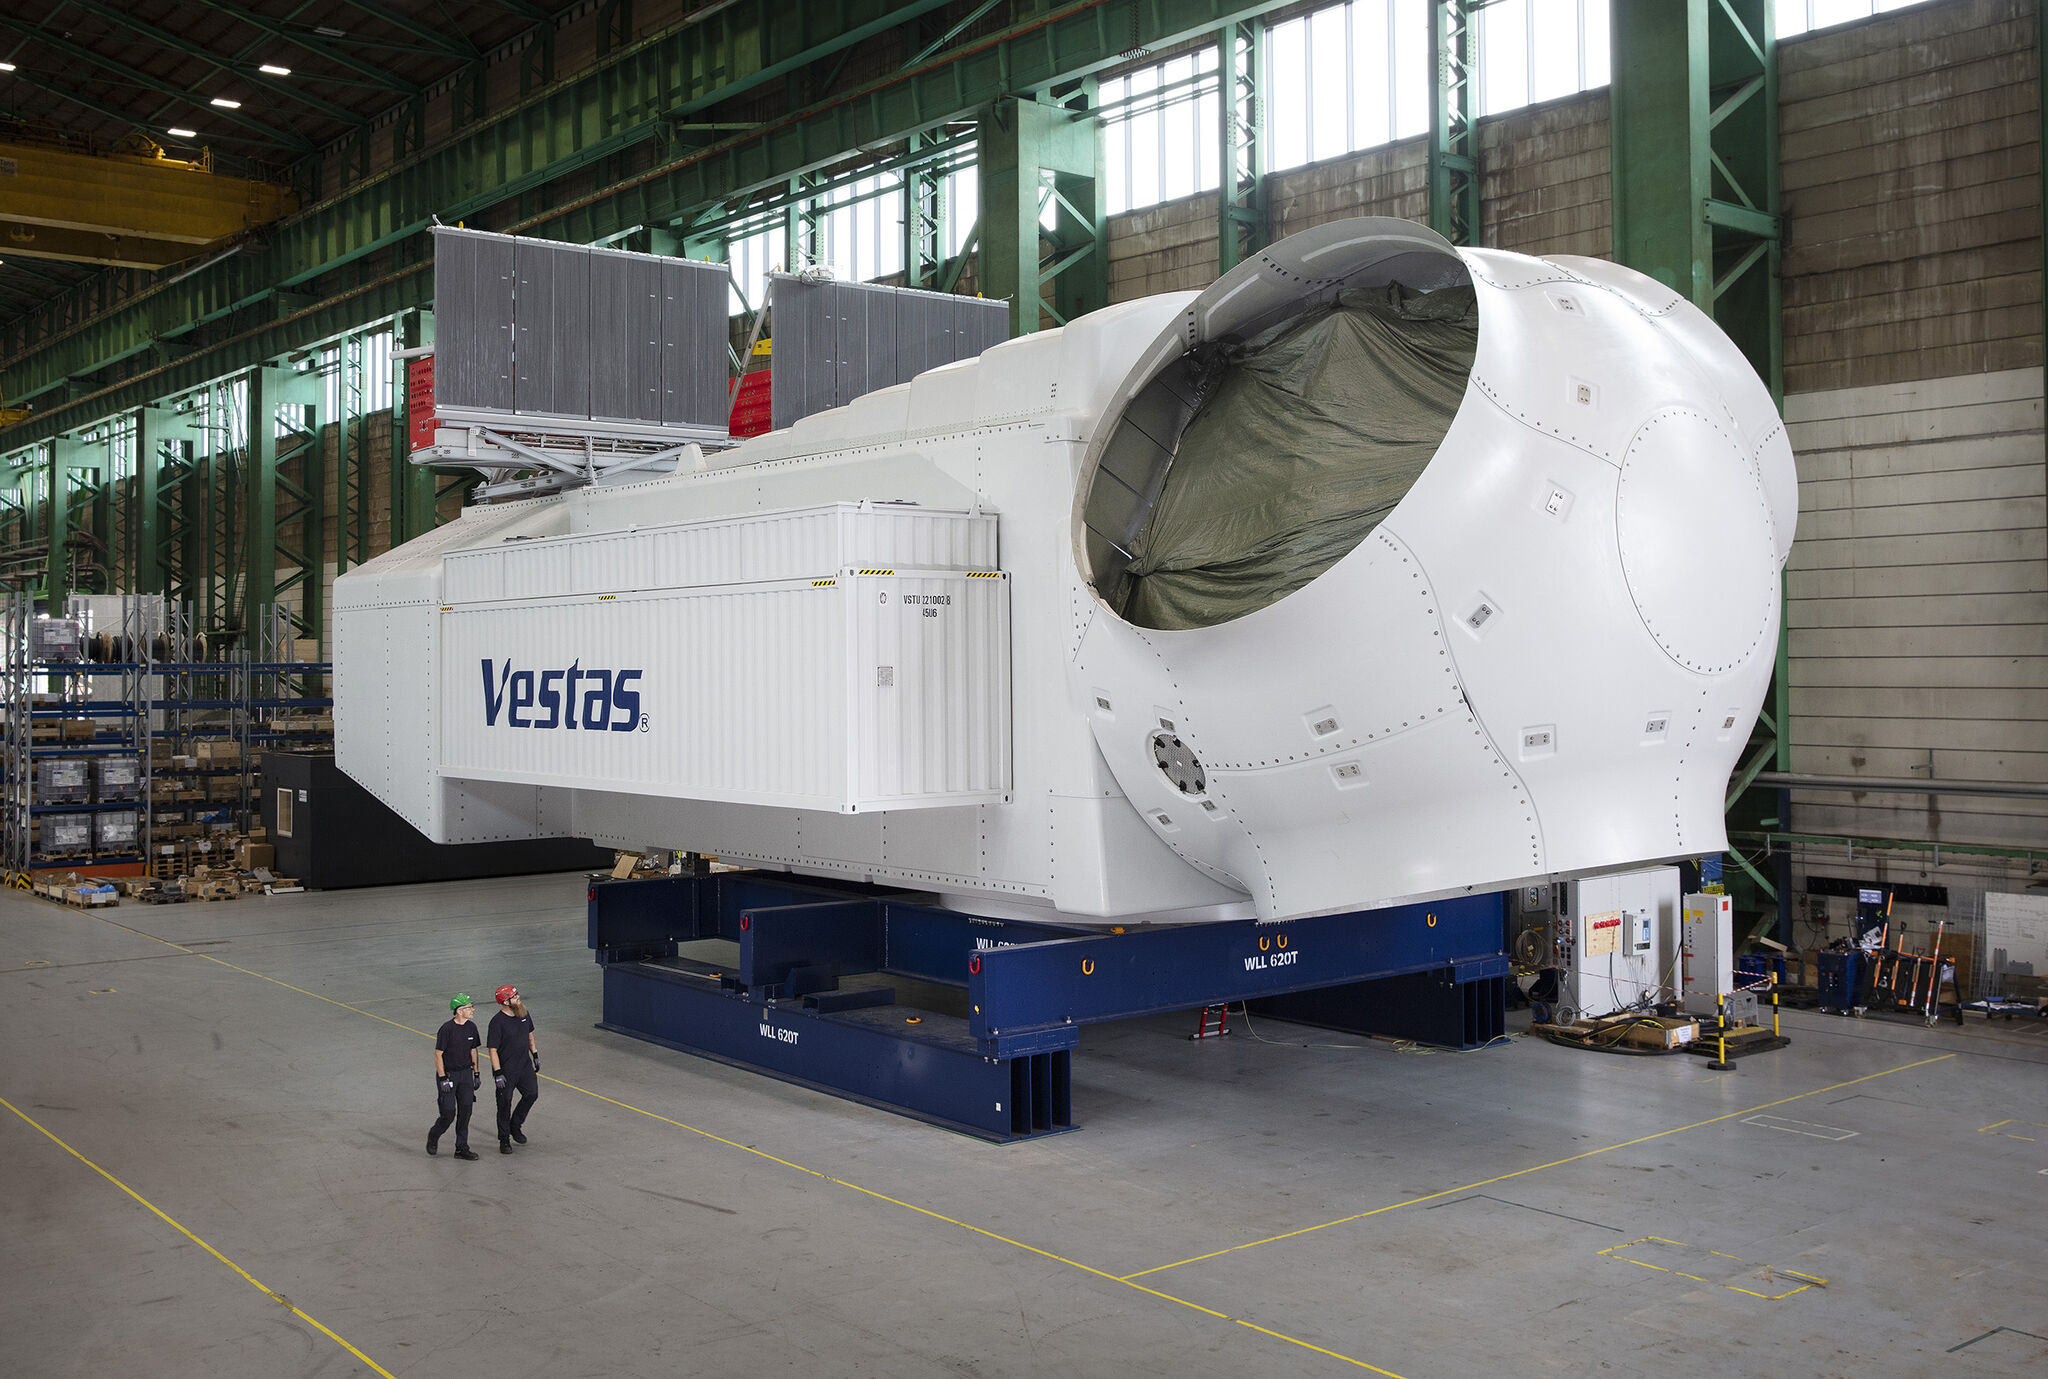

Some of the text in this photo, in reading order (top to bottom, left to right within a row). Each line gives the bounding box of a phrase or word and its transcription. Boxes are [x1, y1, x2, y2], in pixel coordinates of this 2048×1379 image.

[903, 594, 921, 604] VSTU
[946, 595, 951, 605] 8
[1244, 950, 1299, 971] WLL 620T
[759, 1023, 799, 1045] WLL 620T
